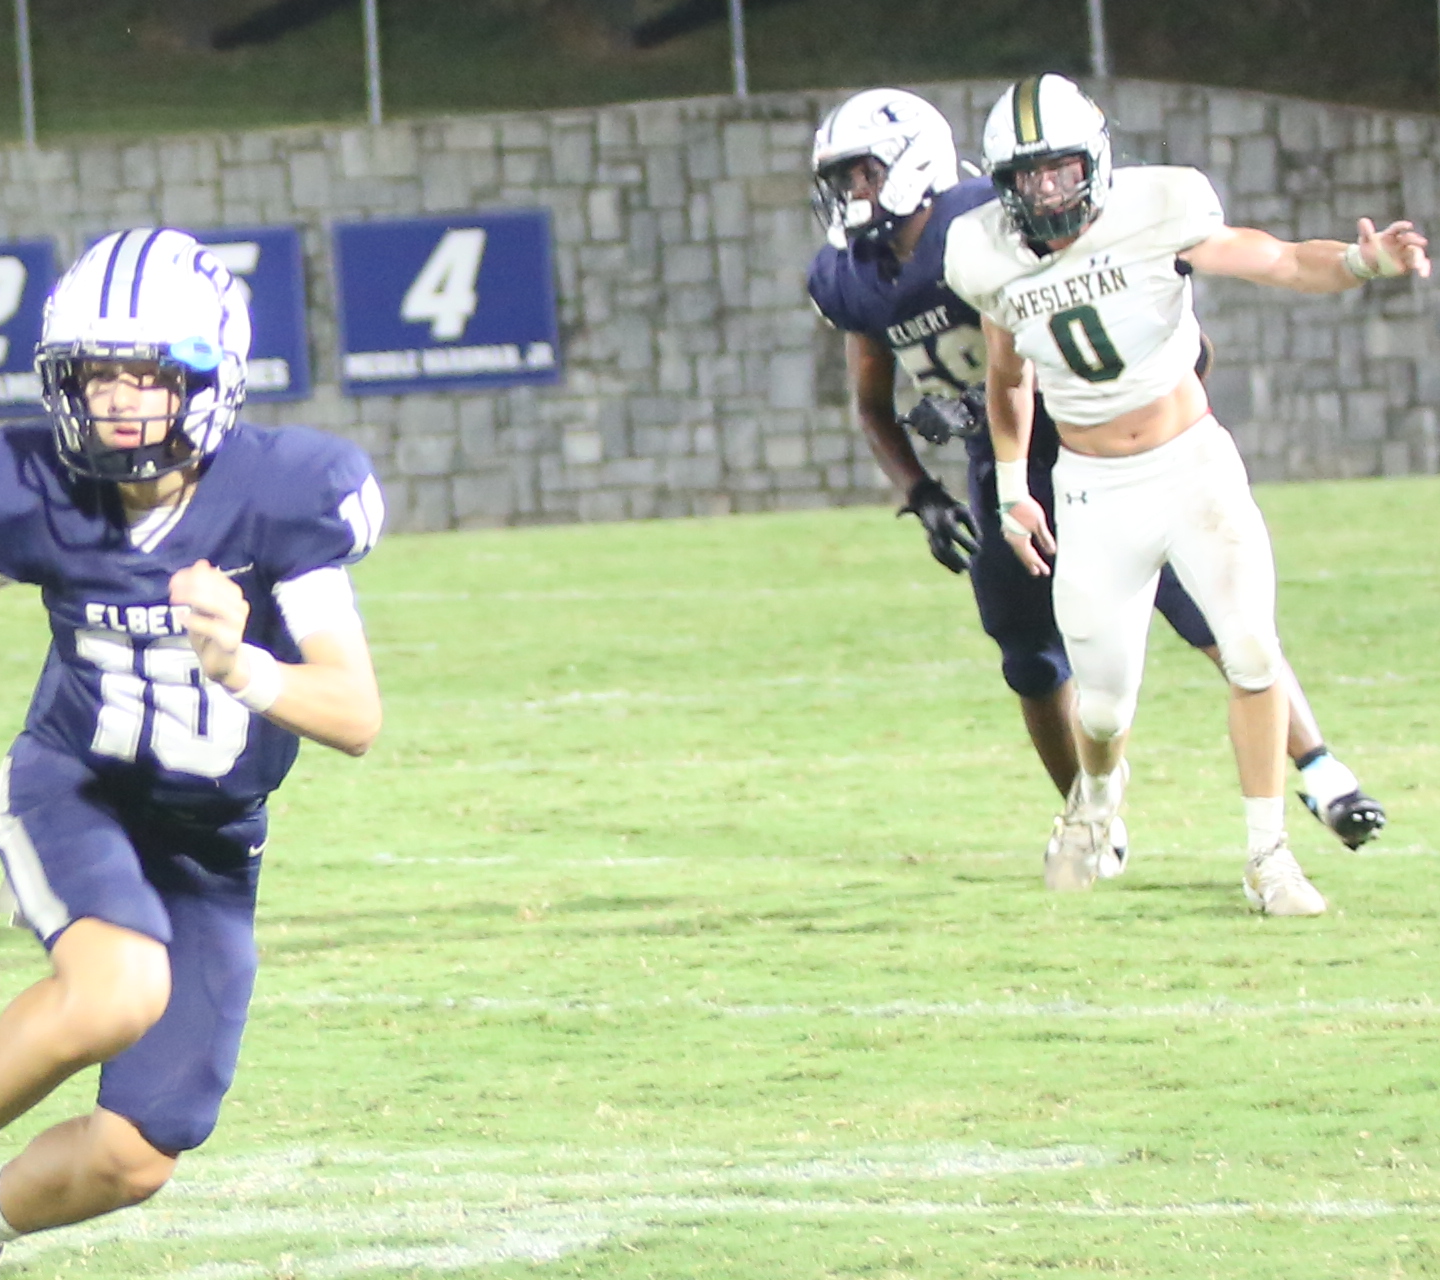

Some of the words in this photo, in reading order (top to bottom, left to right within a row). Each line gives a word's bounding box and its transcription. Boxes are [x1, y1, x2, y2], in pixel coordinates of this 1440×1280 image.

[400, 226, 487, 341] 4
[1009, 267, 1129, 320] WESLEYAN
[886, 305, 951, 347] ELBERT
[1049, 303, 1127, 385] 0
[74, 628, 250, 779] 10
